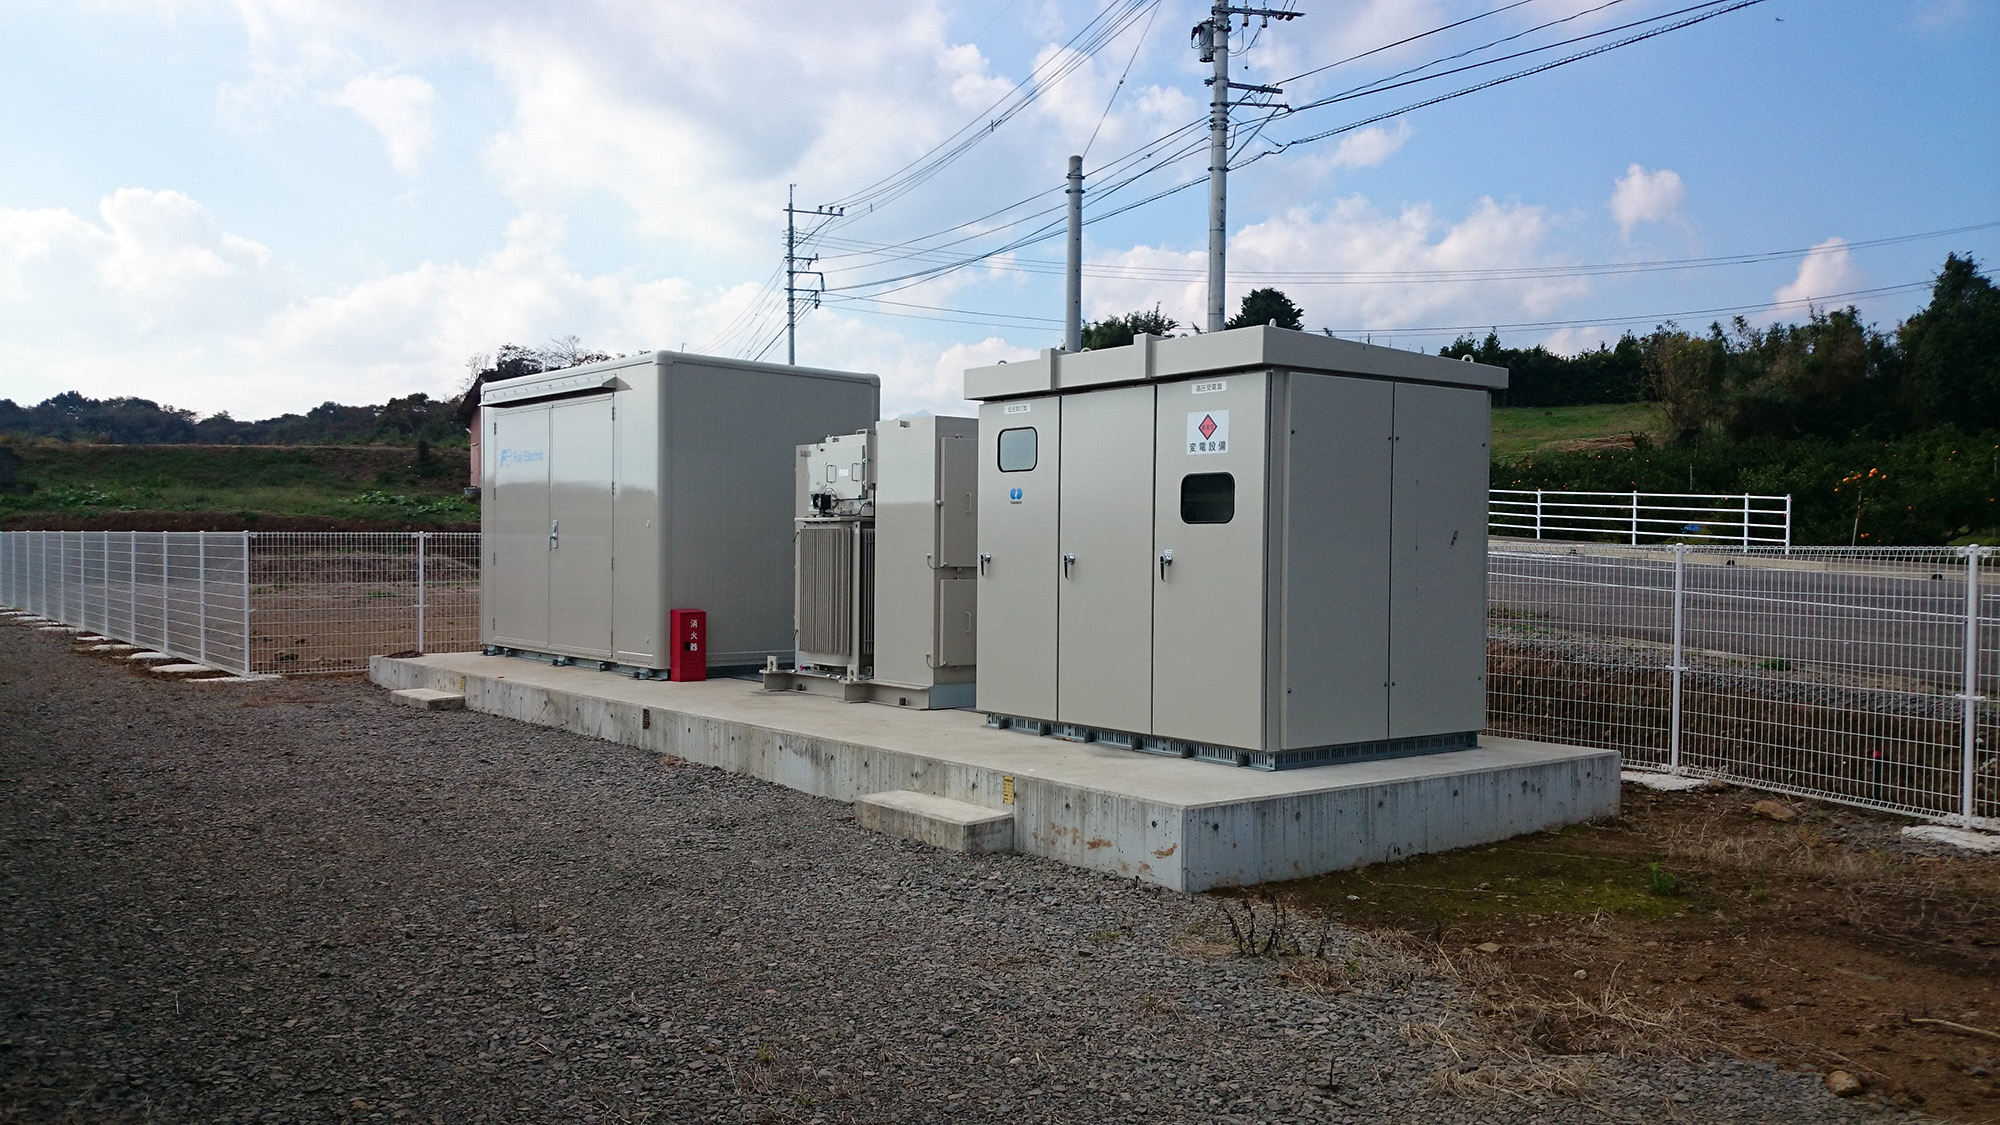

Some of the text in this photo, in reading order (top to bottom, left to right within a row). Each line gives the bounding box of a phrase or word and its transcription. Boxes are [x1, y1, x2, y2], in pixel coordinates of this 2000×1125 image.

[1189, 441, 1226, 453] 変電設備
[513, 451, 523, 464] Fuji
[524, 450, 544, 462] Electric
[690, 619, 698, 652] 消火器
